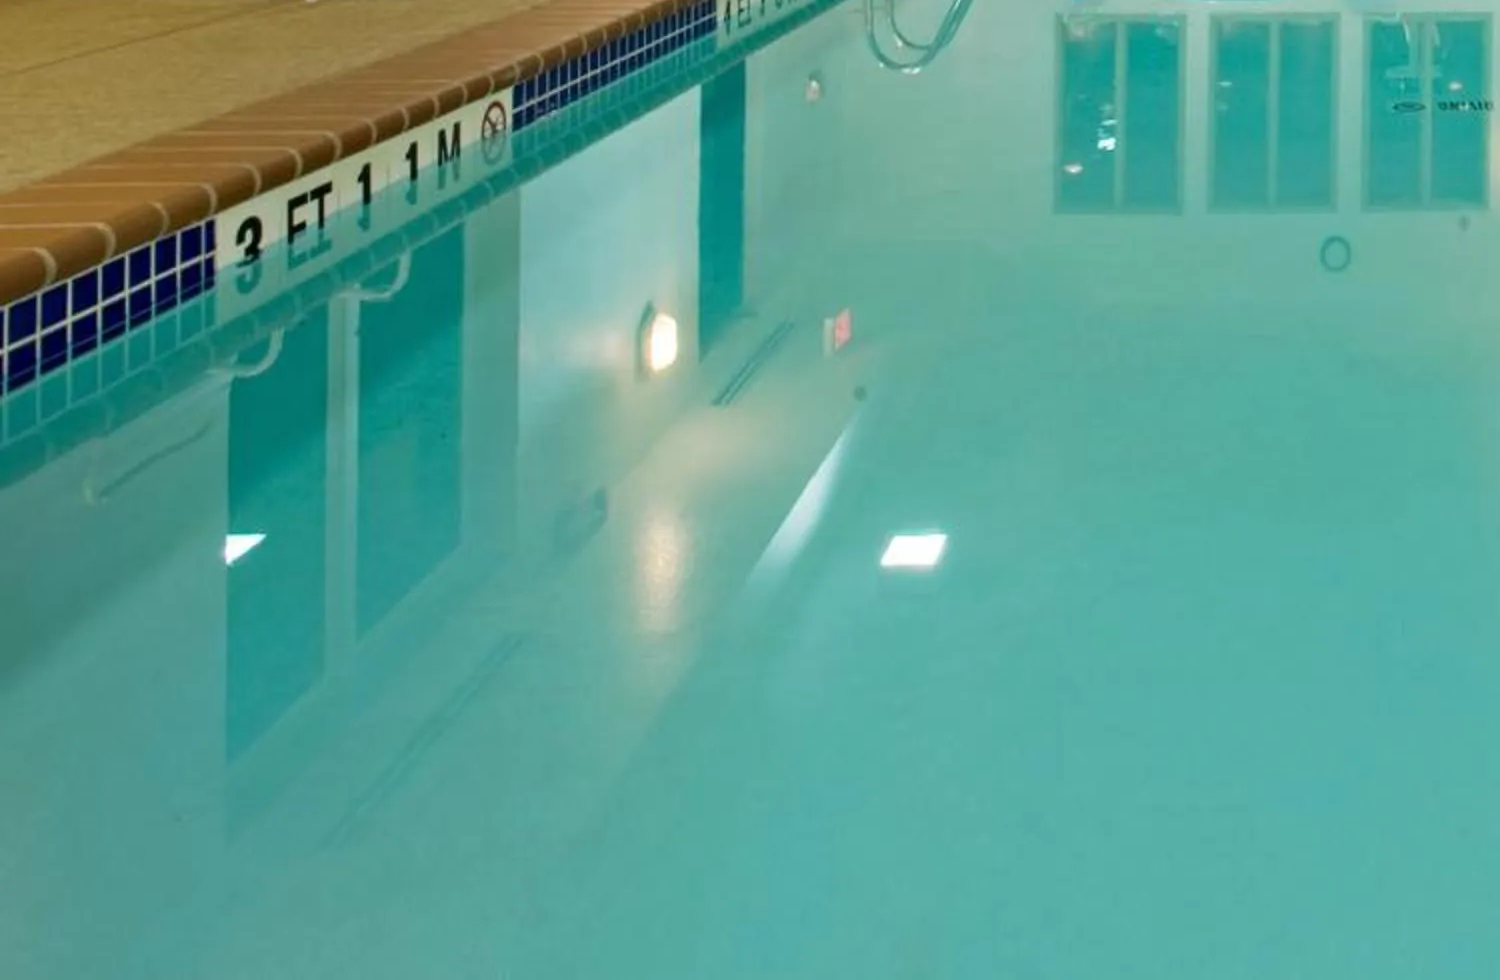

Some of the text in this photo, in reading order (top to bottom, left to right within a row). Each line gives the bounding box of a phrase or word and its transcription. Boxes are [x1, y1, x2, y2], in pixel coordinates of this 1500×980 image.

[235, 121, 462, 266] 3 FT 1 1 M
